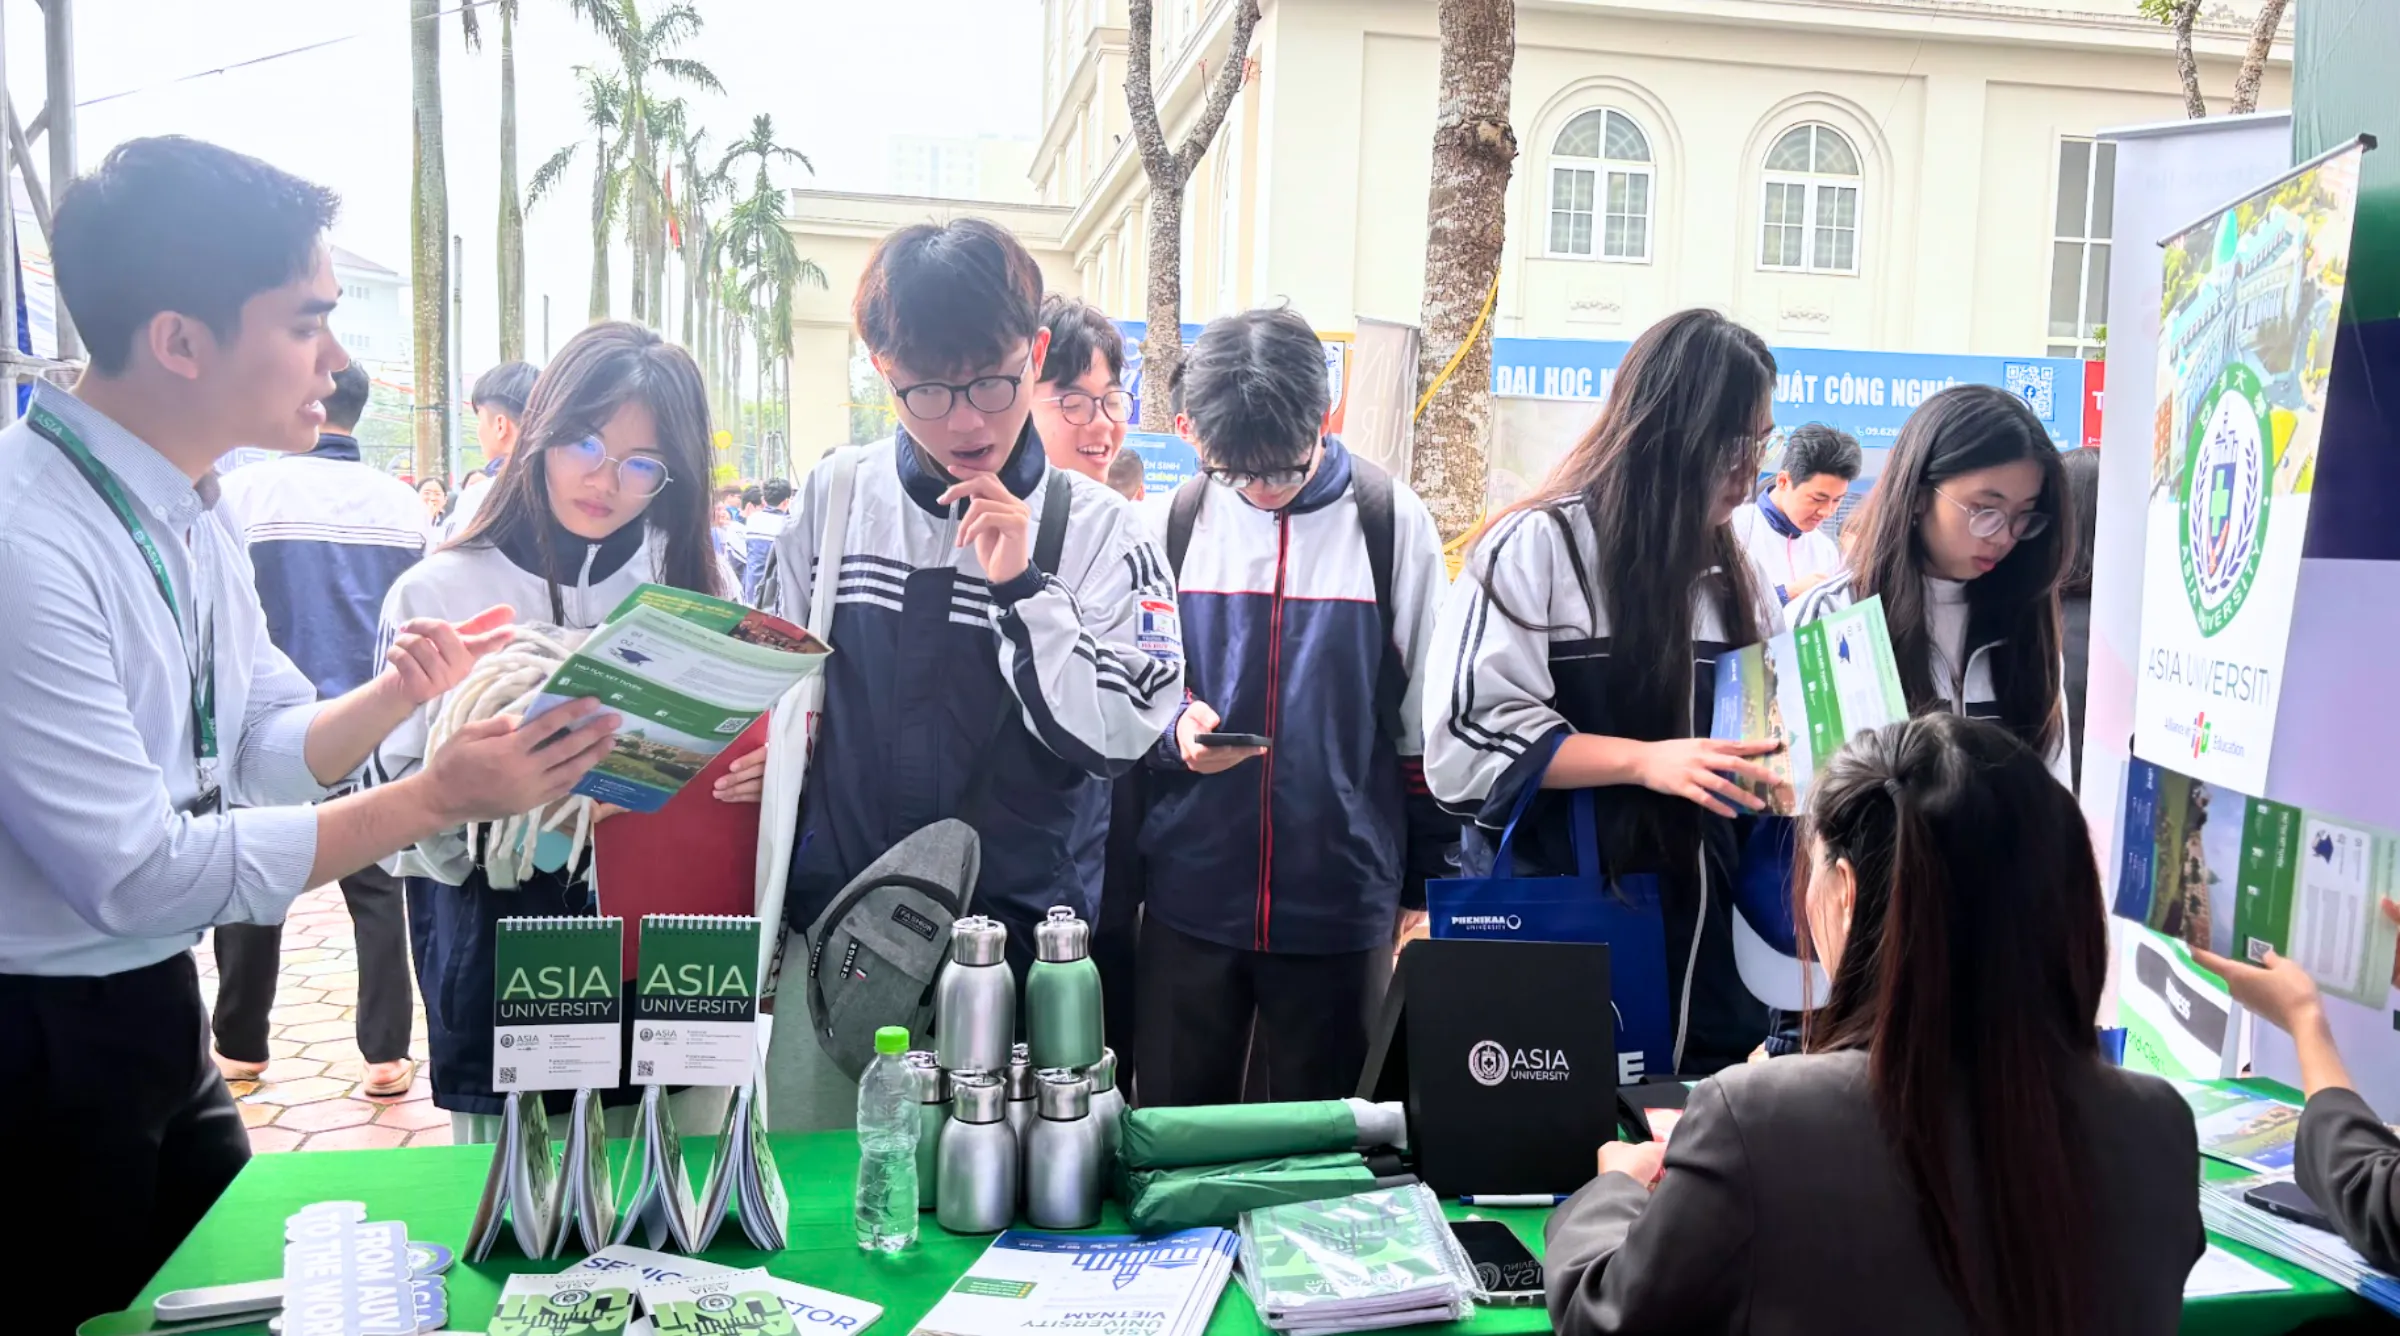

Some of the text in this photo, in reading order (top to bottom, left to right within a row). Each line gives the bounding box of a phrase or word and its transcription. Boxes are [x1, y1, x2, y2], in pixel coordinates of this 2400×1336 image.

[1824, 372, 1884, 406] CÔNG
[35, 414, 62, 437] ASIA
[144, 544, 163, 575] ASIA
[1451, 916, 1505, 925] PHENIKAA
[840, 942, 858, 979] SENIOR
[502, 966, 612, 1000] ASIA
[643, 963, 749, 996] ASIA
[501, 1002, 612, 1018] UNIVERSITY
[641, 998, 749, 1014] UNIVERSITY
[516, 1035, 540, 1043] ASIA
[655, 1029, 677, 1037] ASIA
[1511, 1049, 1569, 1070] ASIA
[1511, 1071, 1570, 1081] UNIVERSITY
[302, 1212, 345, 1336] TO THE WOR
[354, 1225, 402, 1329] FROM AUV
[1020, 1319, 1163, 1328] UNIVERSITY
[1064, 1311, 1166, 1319] VIETNAM
